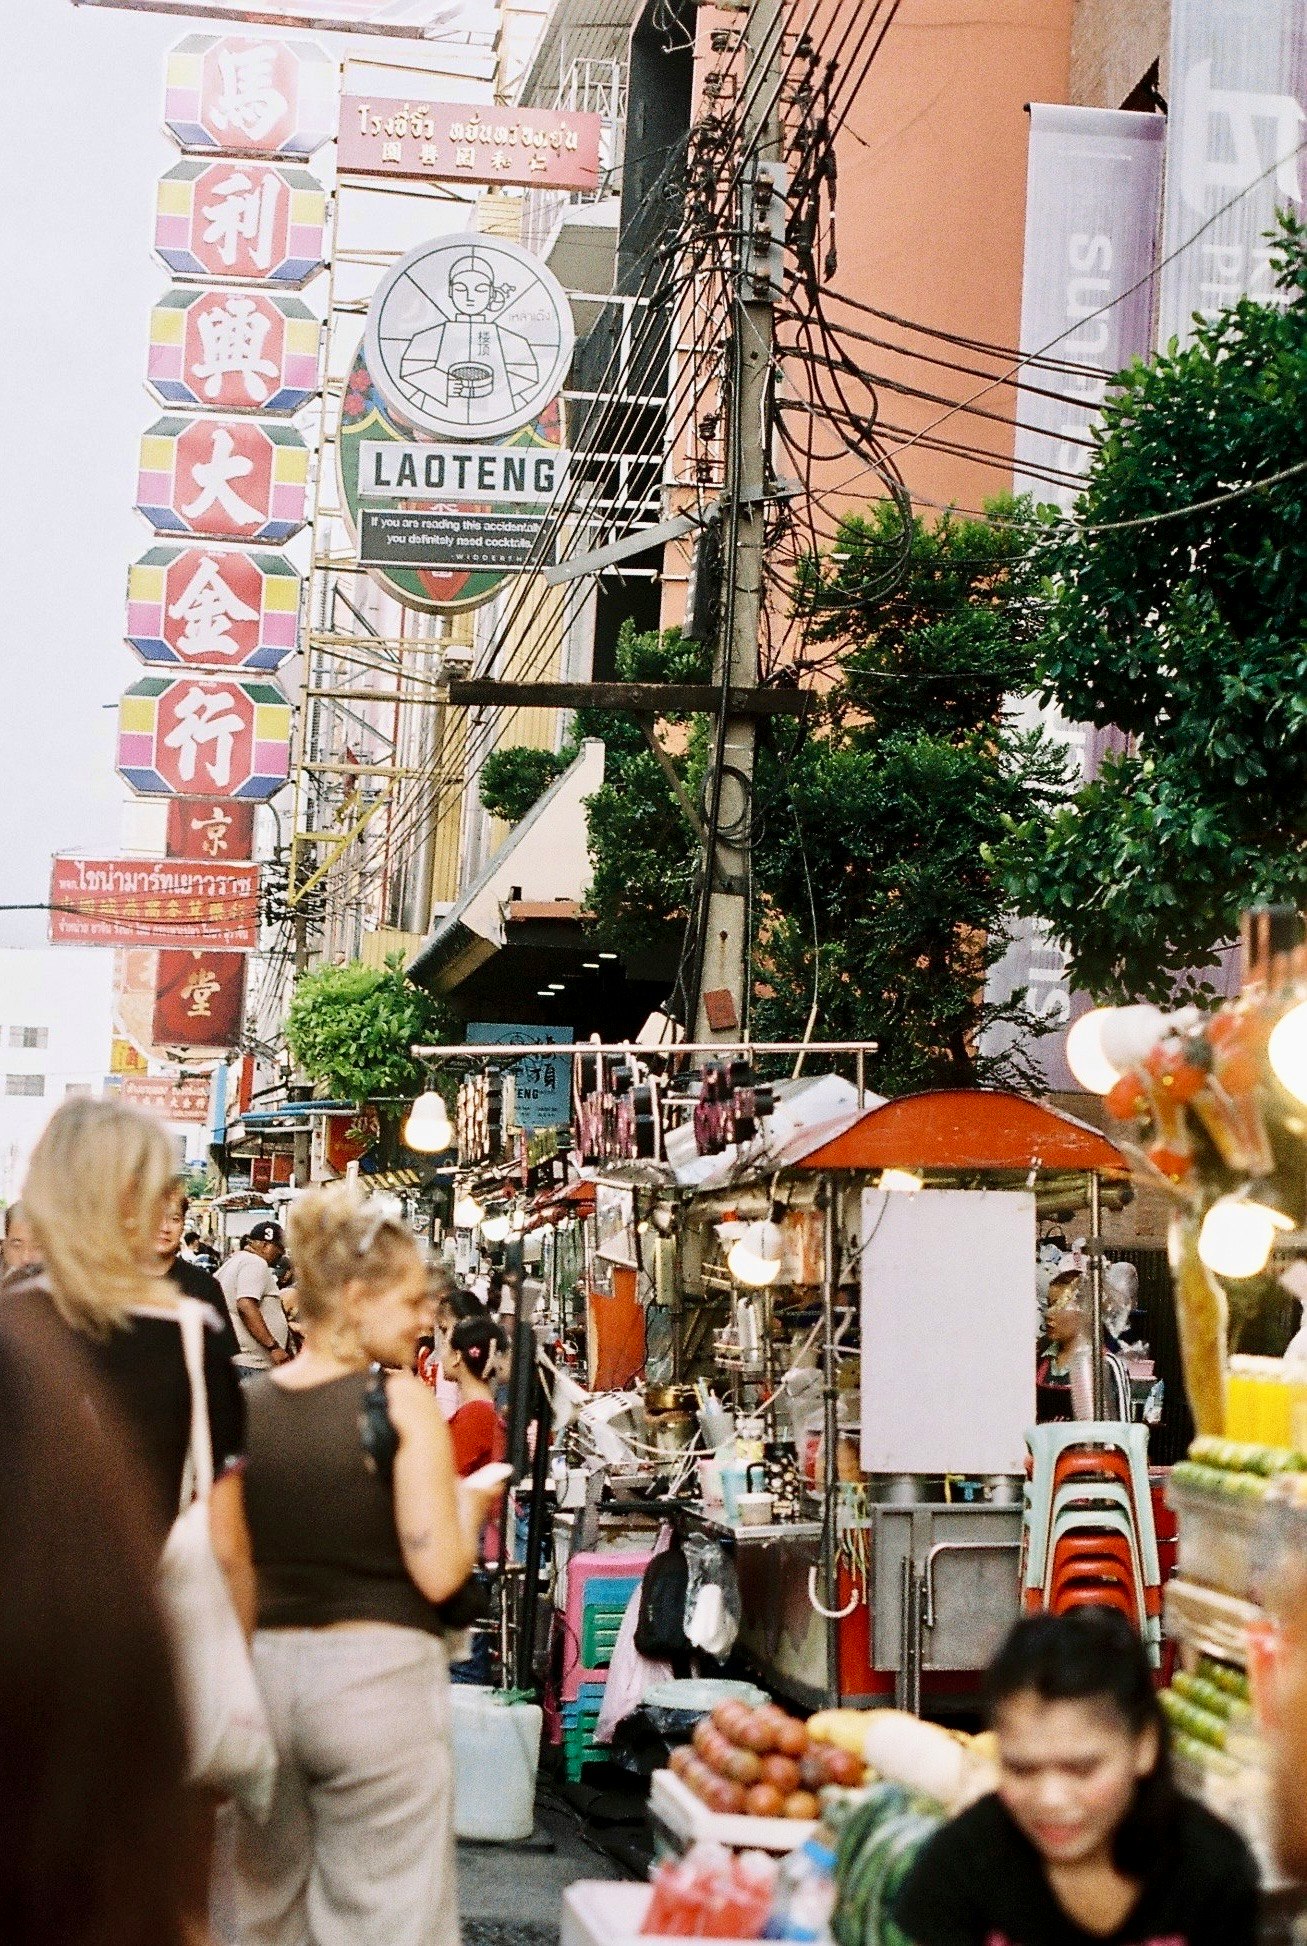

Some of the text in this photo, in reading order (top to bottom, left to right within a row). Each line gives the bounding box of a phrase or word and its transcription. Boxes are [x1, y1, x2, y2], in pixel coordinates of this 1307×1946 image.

[374, 451, 555, 493] LAOTENG
[371, 516, 379, 527] If
[381, 518, 401, 529] you
[402, 519, 419, 529] are
[421, 518, 460, 533] reading
[462, 519, 482, 531] this
[386, 534, 406, 545] you
[408, 532, 454, 547] definitely
[456, 535, 483, 547] need
[515, 1088, 539, 1100] ENG
[264, 1227, 274, 1241] 3
